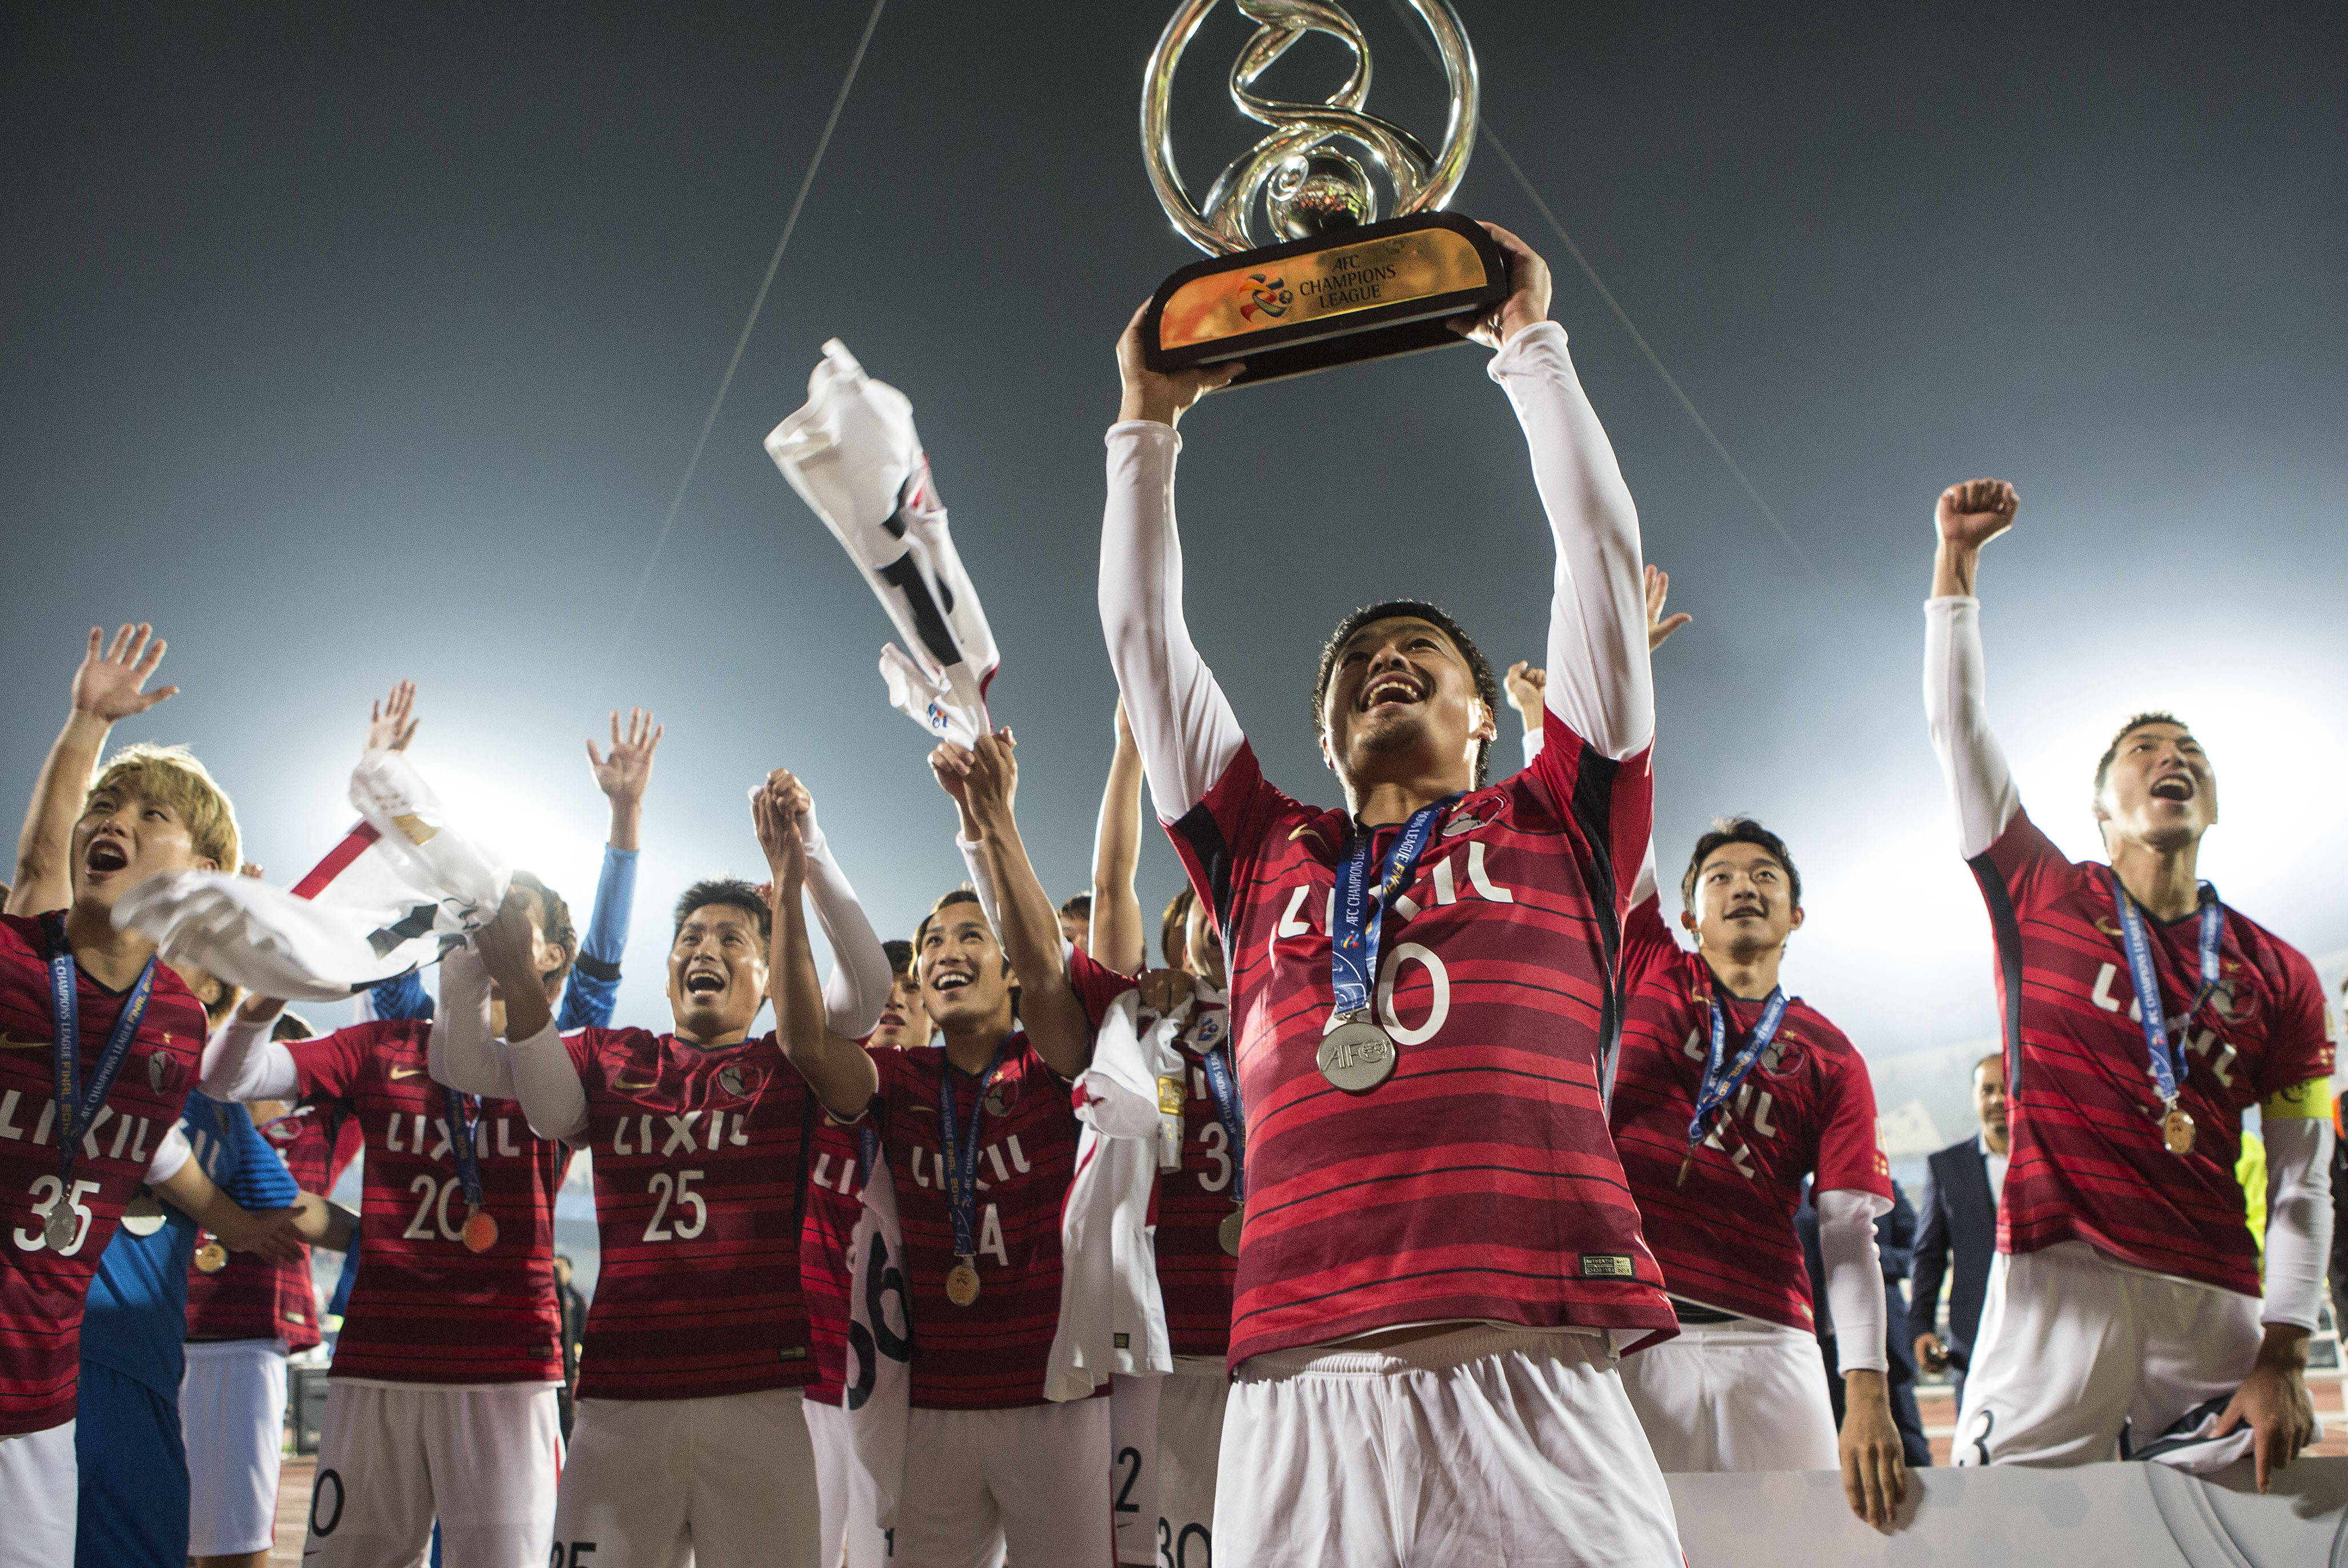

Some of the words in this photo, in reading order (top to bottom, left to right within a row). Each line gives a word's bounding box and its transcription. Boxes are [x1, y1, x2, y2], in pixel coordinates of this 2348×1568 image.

[1299, 264, 1396, 296] CHAMPIONS
[1332, 255, 1359, 271] AFC
[1320, 284, 1381, 308] LEAGUE
[1396, 829, 1420, 863] LEAGUE
[1347, 861, 1363, 906] CHAMPIONS
[1346, 908, 1360, 927] AFC
[55, 966, 70, 1019] CHAMPIONS
[1323, 942, 1451, 1046] 0
[60, 1022, 72, 1059] LEAGUE
[87, 1055, 118, 1103] CHAMPIONS
[127, 995, 147, 1024] FINAL
[1322, 1040, 1388, 1072] AFC
[60, 1061, 73, 1100] FINAL
[613, 1111, 749, 1157] LIXIL
[13, 1175, 101, 1256] 35
[643, 1171, 708, 1242] 25
[1115, 1447, 1141, 1513] 2
